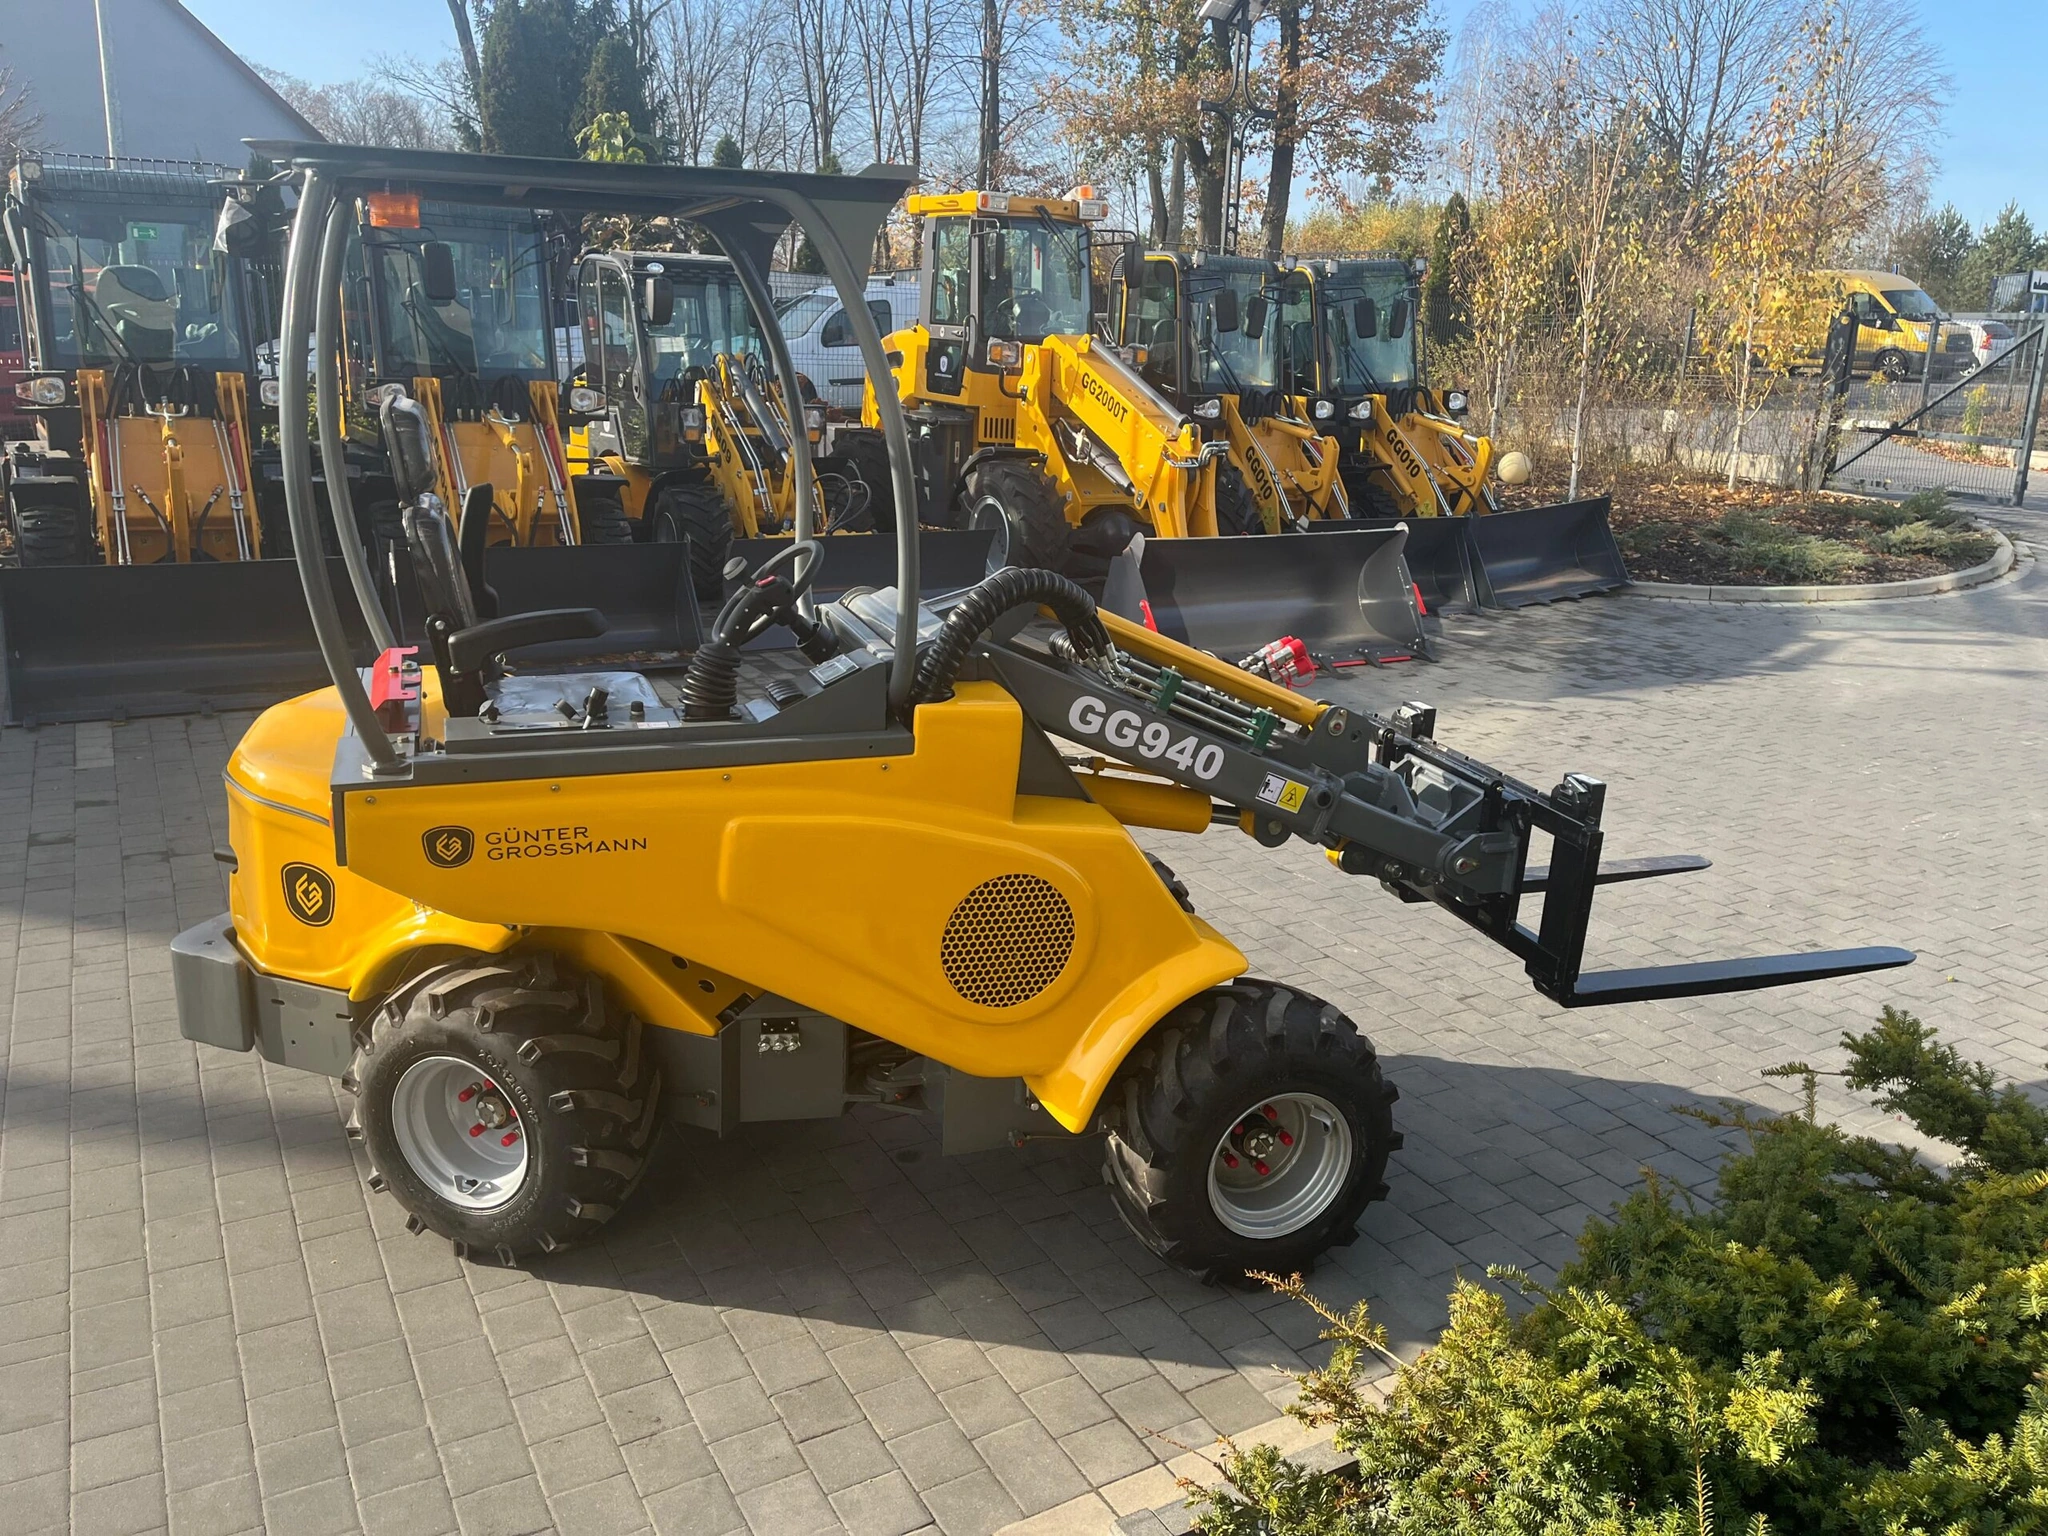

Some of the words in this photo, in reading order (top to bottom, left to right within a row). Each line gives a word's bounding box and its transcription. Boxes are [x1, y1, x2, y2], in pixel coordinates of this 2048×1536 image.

[1081, 372, 1128, 423] GG2000T
[1245, 445, 1273, 500] GG010
[1386, 429, 1421, 478] GG010
[1068, 695, 1225, 781] GG940
[485, 826, 589, 846] GÜNTER
[487, 837, 648, 861] GROSSMANN
